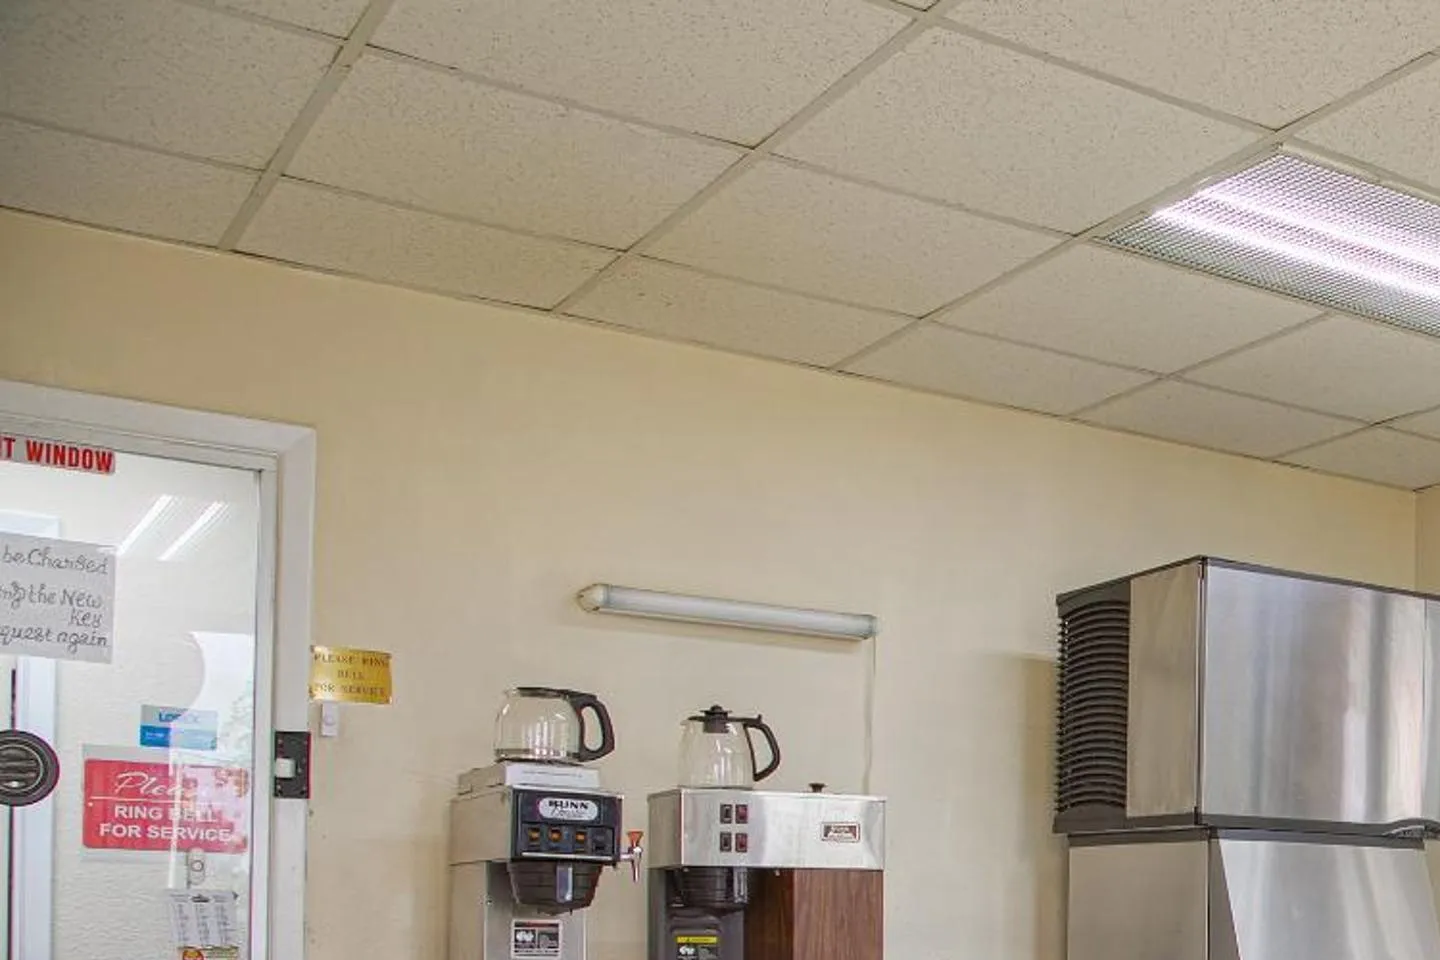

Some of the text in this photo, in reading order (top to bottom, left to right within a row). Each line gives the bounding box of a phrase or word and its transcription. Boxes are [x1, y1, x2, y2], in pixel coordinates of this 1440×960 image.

[25, 439, 113, 473] WINDOW
[28, 583, 57, 605] the
[60, 588, 102, 609] New
[68, 608, 103, 629] Key
[56, 629, 108, 654] again
[114, 804, 163, 821] RING
[547, 799, 589, 810] BUNN
[98, 822, 233, 843] FOR SERVICE
